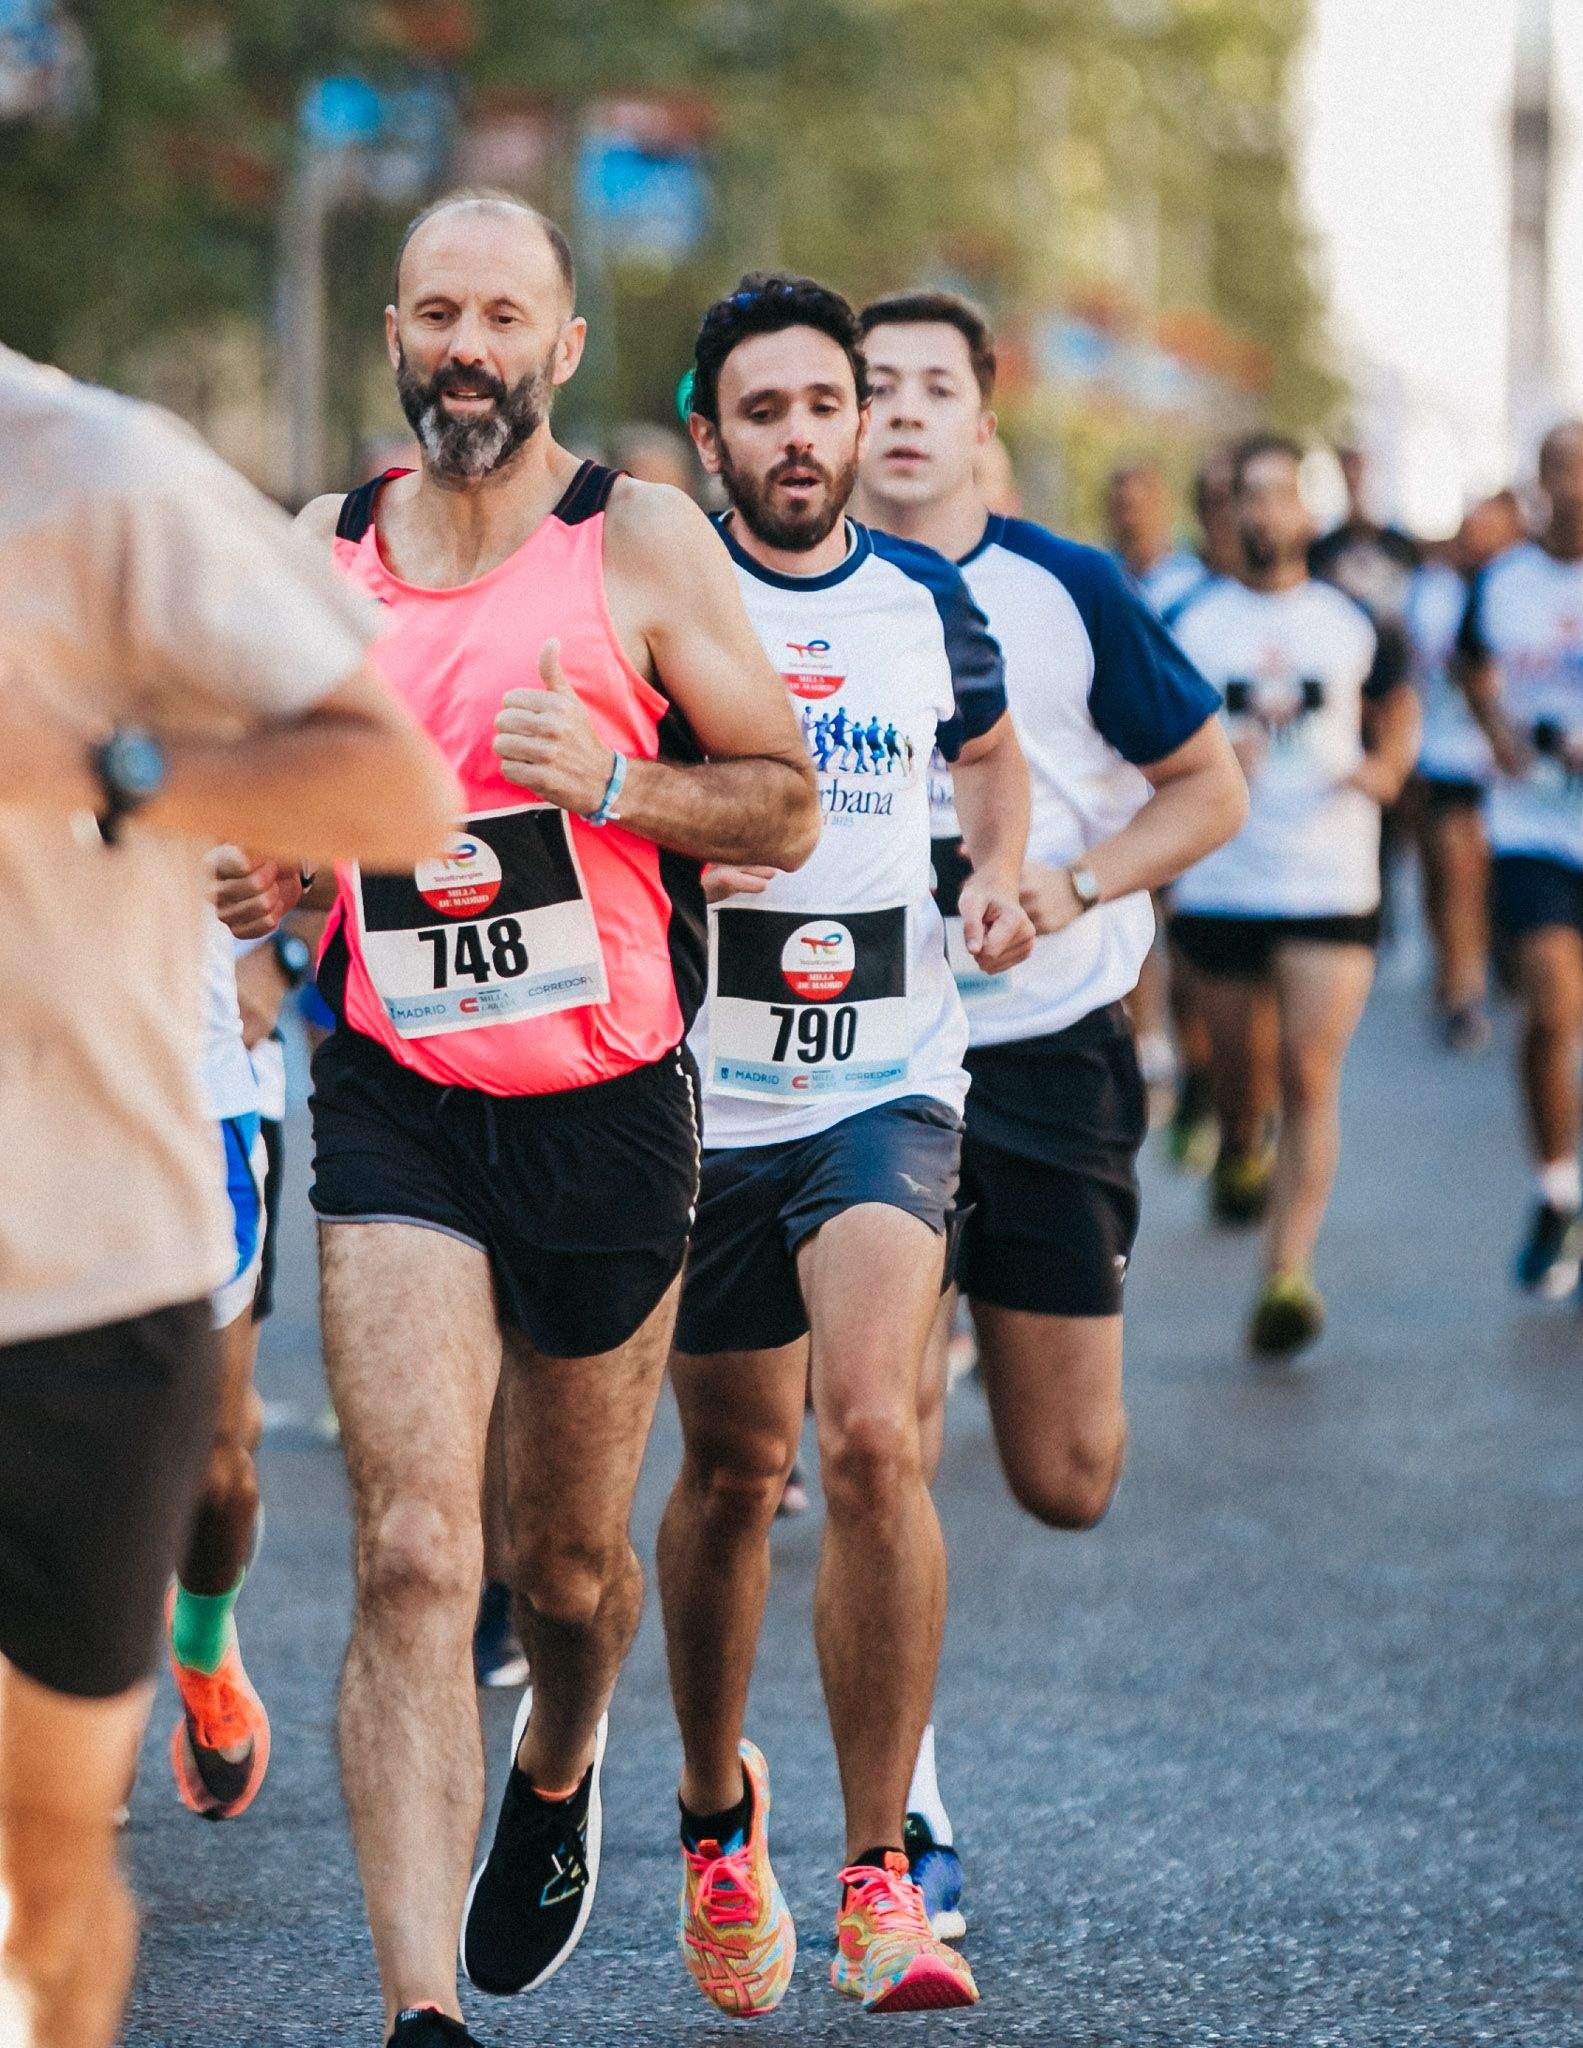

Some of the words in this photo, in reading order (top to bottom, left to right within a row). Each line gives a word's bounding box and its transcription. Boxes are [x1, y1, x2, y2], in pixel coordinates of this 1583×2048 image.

[819, 778, 893, 816] rbana
[447, 887, 477, 897] MILLA
[453, 894, 490, 906] MADRID
[418, 917, 529, 989] 748
[396, 1004, 447, 1019] MADRID
[770, 1005, 858, 1064] 790
[735, 1070, 780, 1085] MADRID
